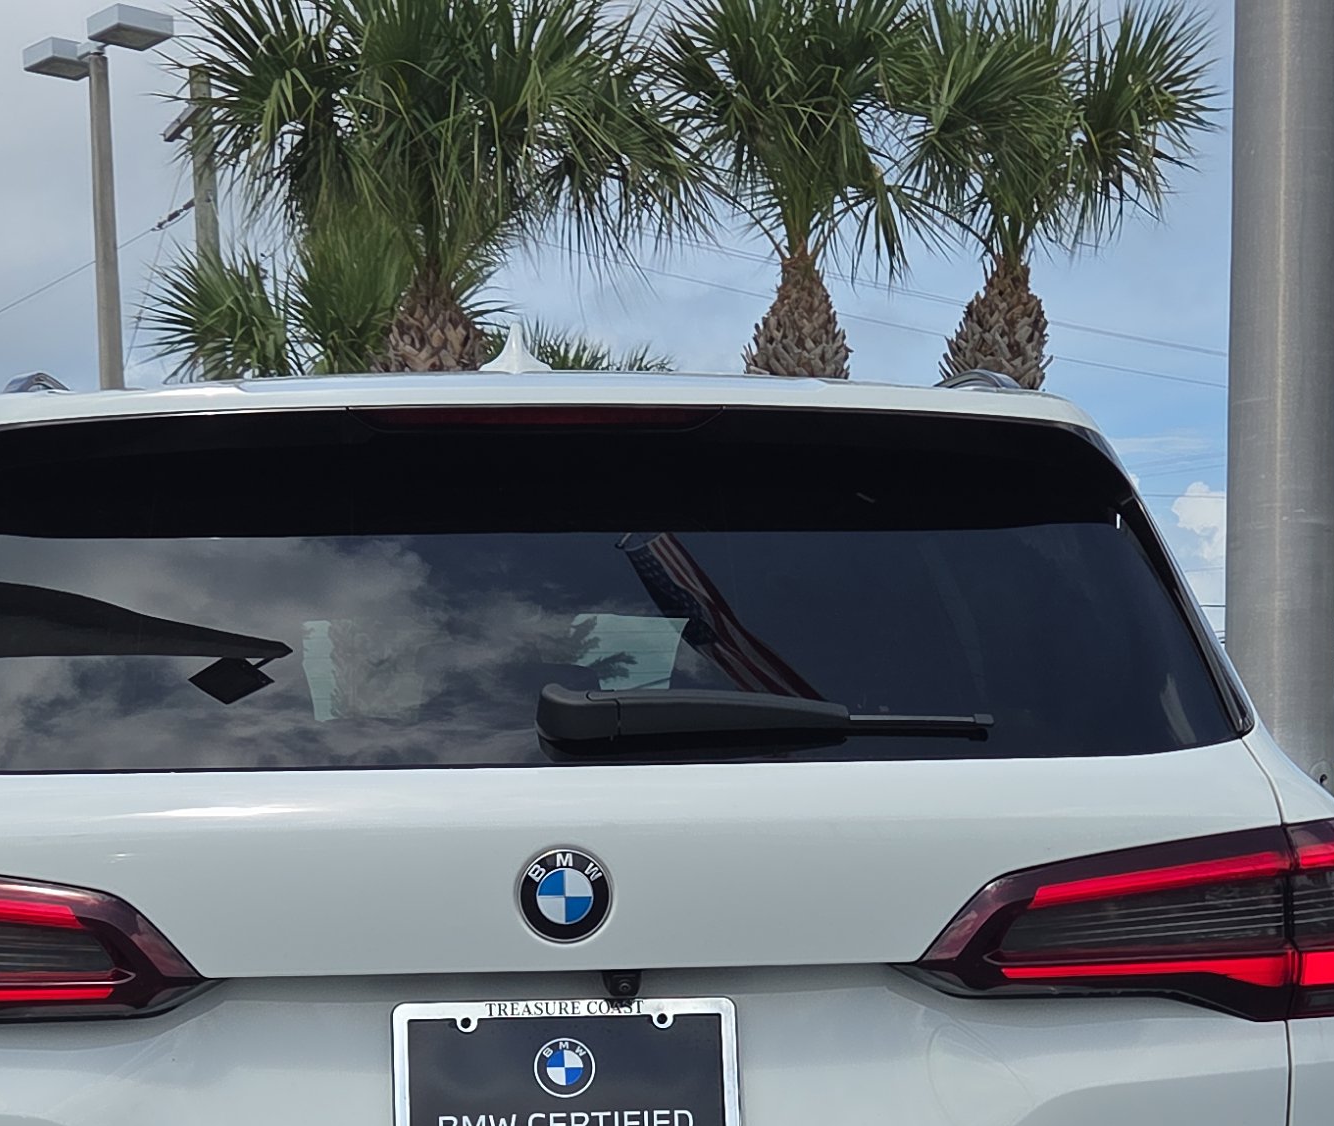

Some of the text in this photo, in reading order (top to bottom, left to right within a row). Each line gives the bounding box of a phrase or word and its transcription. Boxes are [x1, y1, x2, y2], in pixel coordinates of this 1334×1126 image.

[528, 853, 602, 882] BMW
[485, 1000, 644, 1017] TREASURE COAST
[542, 1041, 587, 1058] BMW
